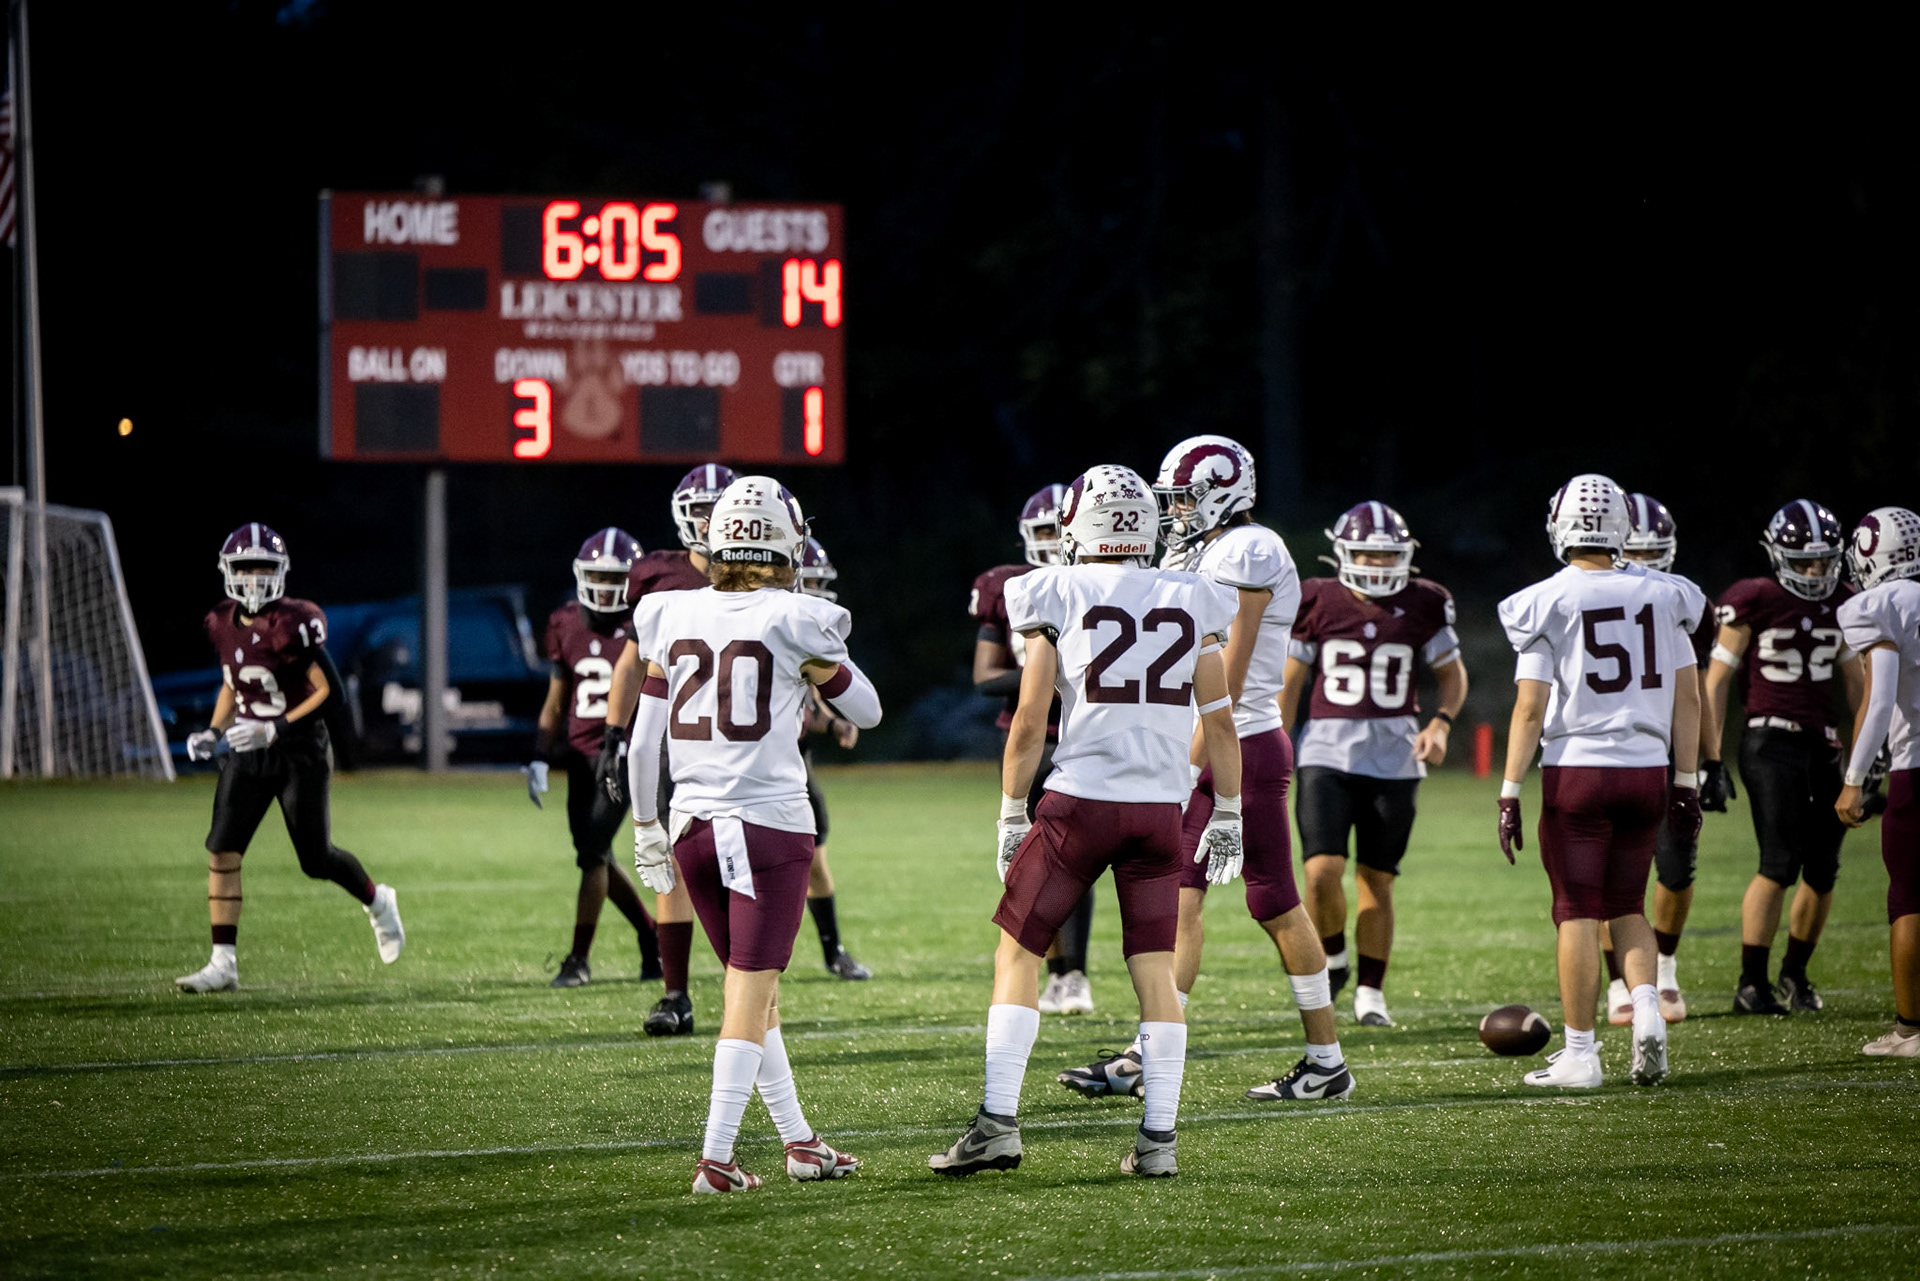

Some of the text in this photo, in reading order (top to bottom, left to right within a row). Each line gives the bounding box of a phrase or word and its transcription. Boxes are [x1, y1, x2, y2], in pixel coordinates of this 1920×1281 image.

[364, 201, 459, 245] HOME
[542, 200, 682, 281] 6:05
[703, 209, 829, 252] GUESTS
[501, 281, 683, 322] LEICESTER
[782, 257, 842, 328] 14
[348, 346, 447, 382] BALL ON
[495, 347, 567, 383] DOWN
[669, 351, 701, 386] TO
[701, 351, 740, 387] GO
[773, 351, 825, 387] QTR
[513, 378, 552, 459] 3
[803, 385, 824, 456] 1
[732, 519, 763, 541] 20
[1112, 511, 1139, 533] 22
[1579, 535, 1608, 544] schutt
[1583, 515, 1602, 532] 51
[721, 549, 772, 563] Riddell
[1098, 543, 1147, 555] Riddell
[298, 617, 326, 648] 13
[1581, 602, 1662, 695] 51
[1082, 605, 1195, 706] 22
[1322, 638, 1413, 709] 60
[1758, 628, 1843, 682] 52
[669, 638, 774, 742] 20
